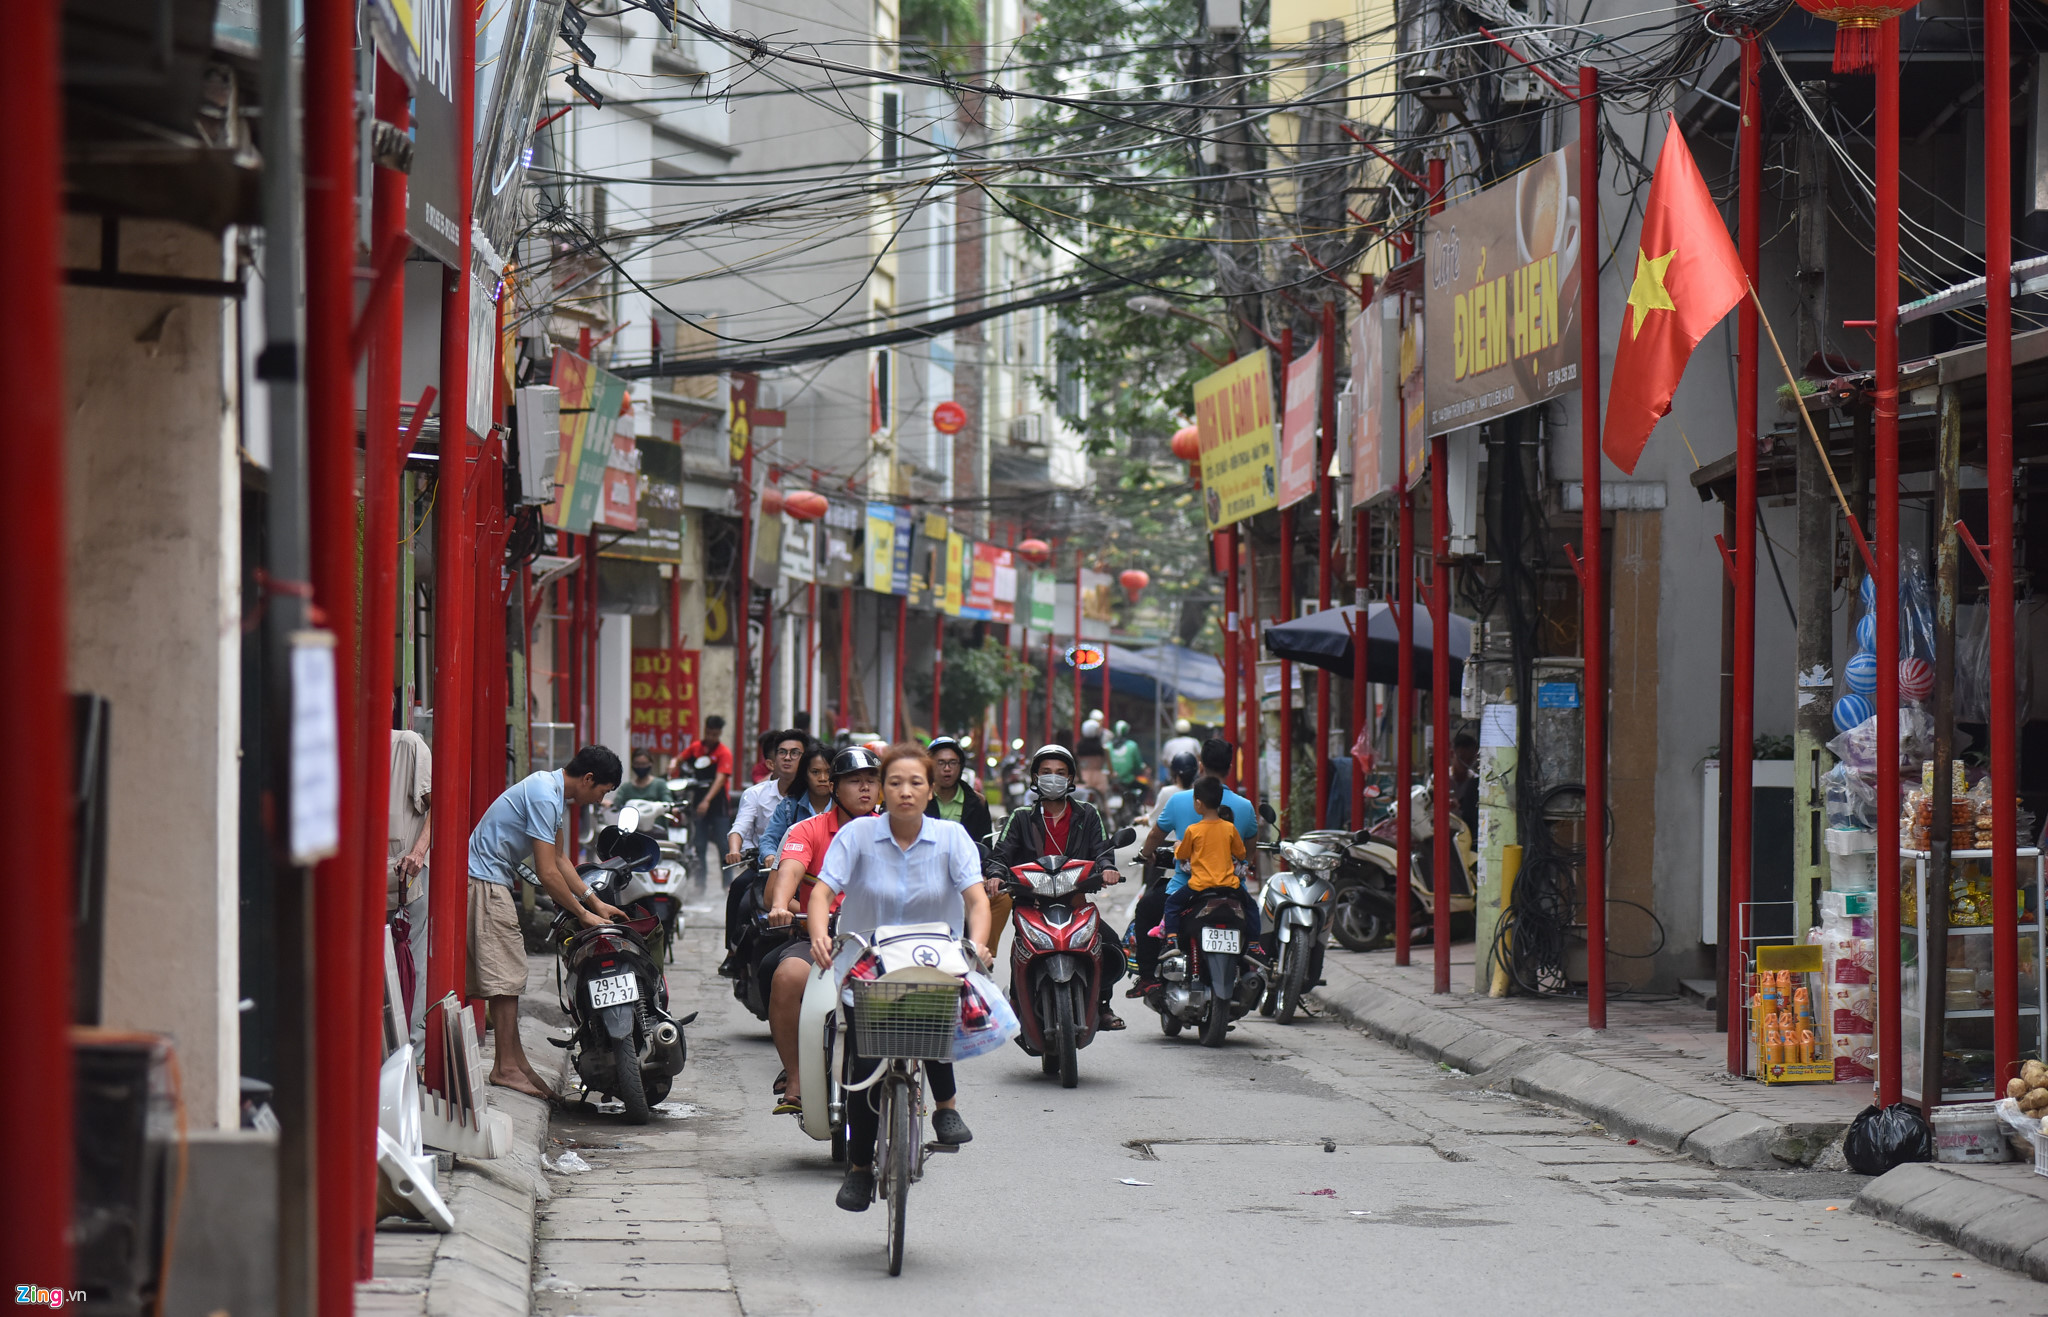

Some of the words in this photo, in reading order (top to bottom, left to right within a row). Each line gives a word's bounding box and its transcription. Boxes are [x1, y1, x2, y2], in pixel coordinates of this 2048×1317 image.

[1454, 246, 1507, 383] ĐIỂM
[1514, 251, 1559, 377] HẸN
[1208, 930, 1234, 941] 29-L1
[1206, 940, 1238, 952] 707.35
[595, 975, 628, 993] 29-L1
[593, 987, 634, 1006] 622.37
